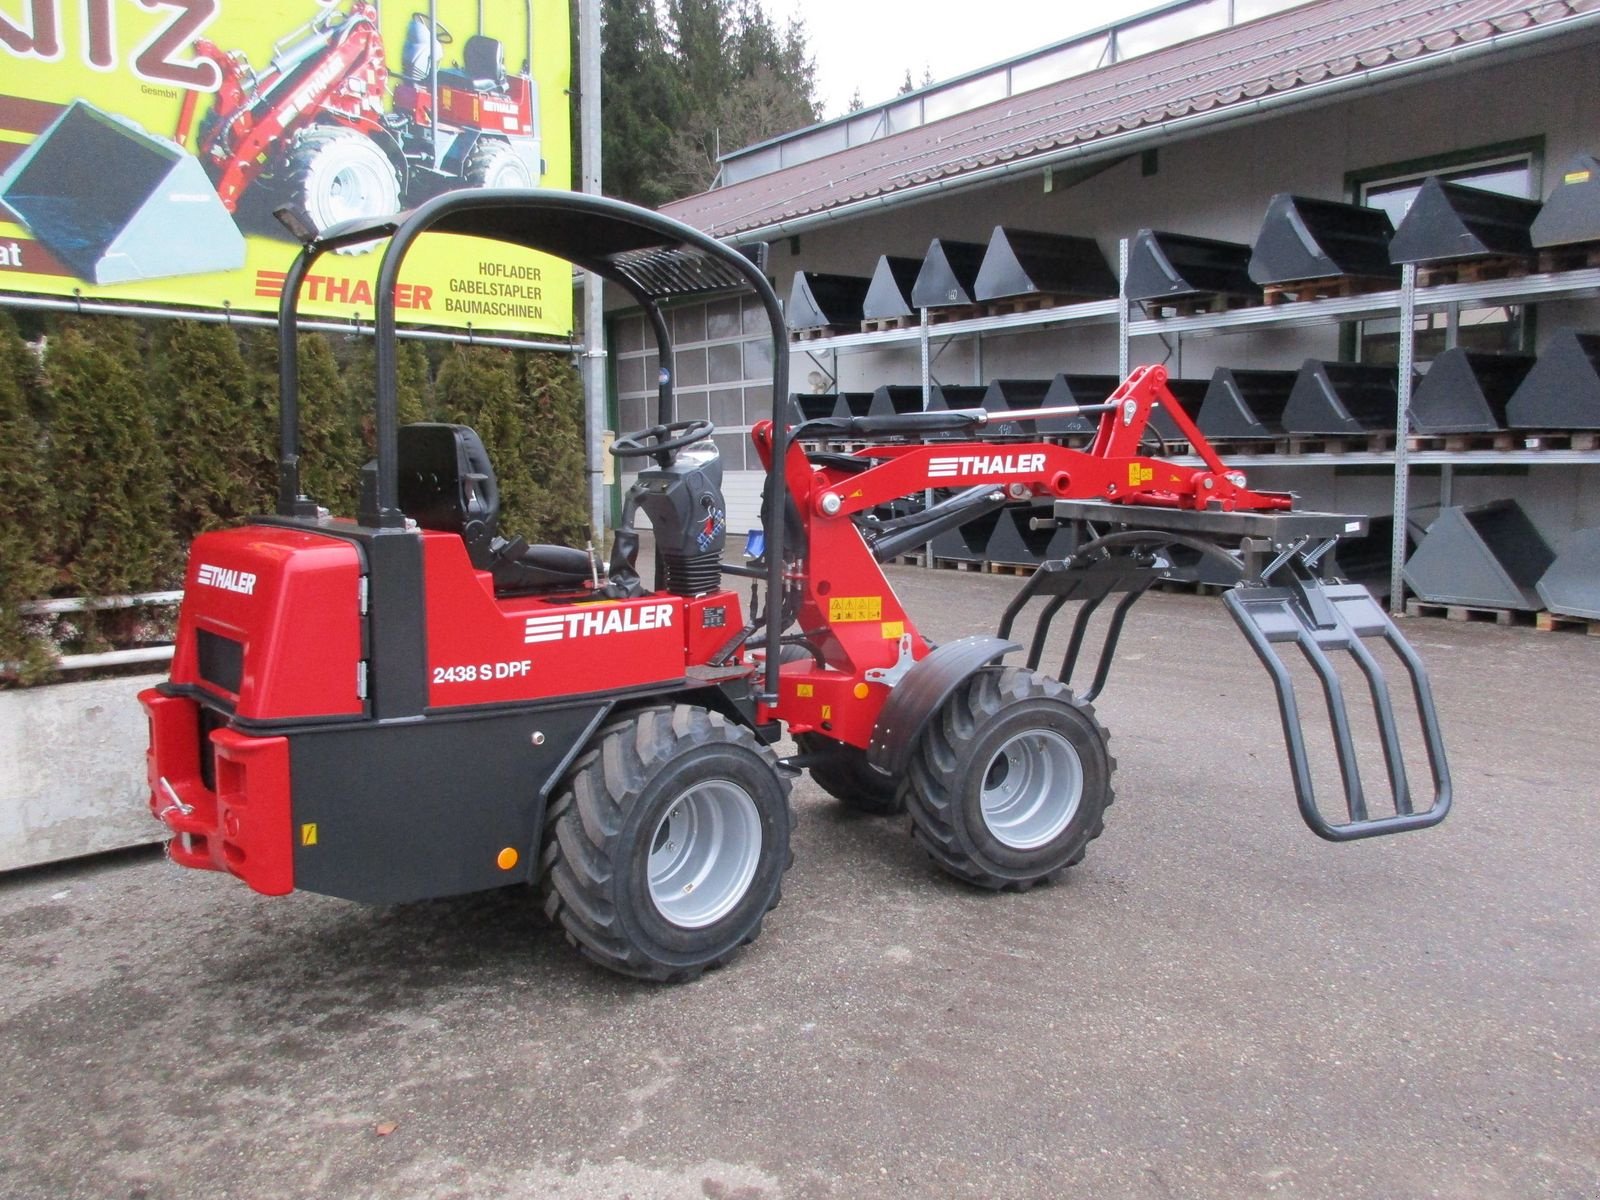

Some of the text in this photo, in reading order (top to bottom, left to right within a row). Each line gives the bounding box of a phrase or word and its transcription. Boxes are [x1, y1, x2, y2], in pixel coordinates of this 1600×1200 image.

[141, 84, 178, 100] GesmbH
[478, 262, 541, 281] HOFLADER
[304, 273, 433, 311] THAER
[449, 278, 542, 300] GABELSTAPLER
[445, 298, 543, 320] BAUMASCHINEN
[959, 453, 1046, 476] THALER
[211, 566, 257, 596] THALER
[565, 604, 673, 638] THALER
[433, 660, 532, 684] 2438 S DPF
